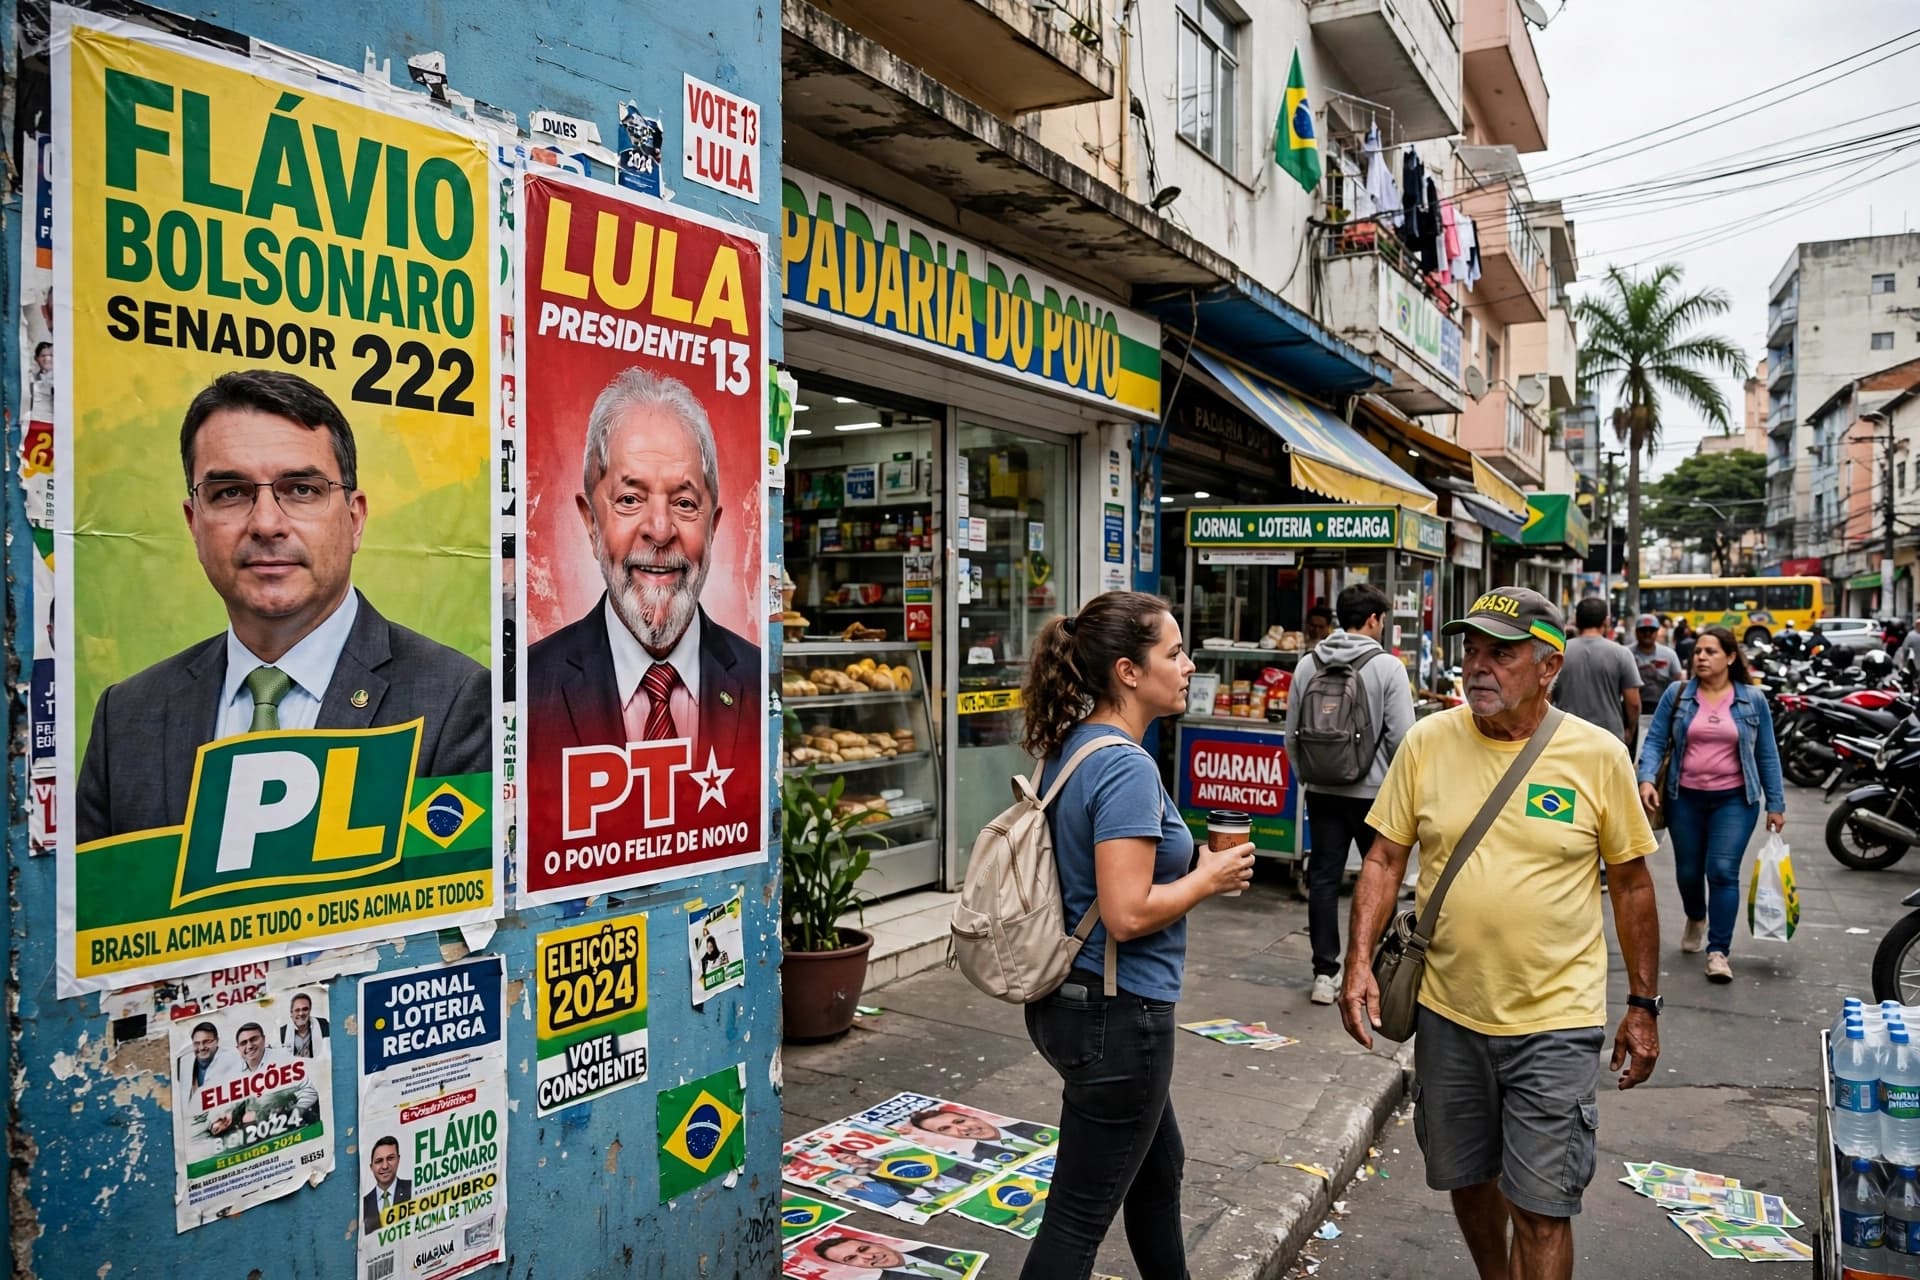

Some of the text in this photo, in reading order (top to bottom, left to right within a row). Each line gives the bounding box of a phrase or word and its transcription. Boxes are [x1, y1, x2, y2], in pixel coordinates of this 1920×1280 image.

[687, 84, 757, 147] VOTE 13
[105, 68, 474, 262] FLÁVIO
[105, 198, 475, 339] BOLSONARO
[541, 197, 749, 336] LULA
[782, 177, 1120, 400] PADARIA DO POVO
[106, 295, 475, 417] SENADOR 222
[538, 302, 751, 396] PRESIDENTE 13
[1194, 516, 1390, 538] JORNAL LOTERIA RECARGA
[1469, 595, 1520, 618] BRASIL
[562, 737, 692, 840] PT
[1194, 751, 1283, 786] GUARANÁ
[216, 747, 386, 874] PL
[1198, 783, 1278, 808] ANTARCTICA
[544, 822, 748, 875] O POVO FELIZ DE NOVO
[91, 879, 484, 966] BRASIL ACIMA DE TUDO DEUS ACIMA DE TODOS
[549, 927, 637, 978] ELEIÇÕES
[385, 972, 475, 1008] JORNAL
[393, 994, 485, 1031] LOTERIA
[553, 964, 635, 1024] 2024
[383, 1016, 486, 1057] RECARGA
[569, 1035, 613, 1068] VOTE
[201, 1061, 305, 1111] ELEIÇÕES
[539, 1050, 645, 1108] CONSCIENTE
[415, 1110, 497, 1164] FLÁVIO
[414, 1142, 497, 1188] BOLSONARO
[378, 1219, 411, 1247] VOTE
[449, 1203, 459, 1220] DE
[386, 1207, 395, 1225] 6
[399, 1200, 416, 1221] DE
[419, 1173, 497, 1212] OUTUBRO
